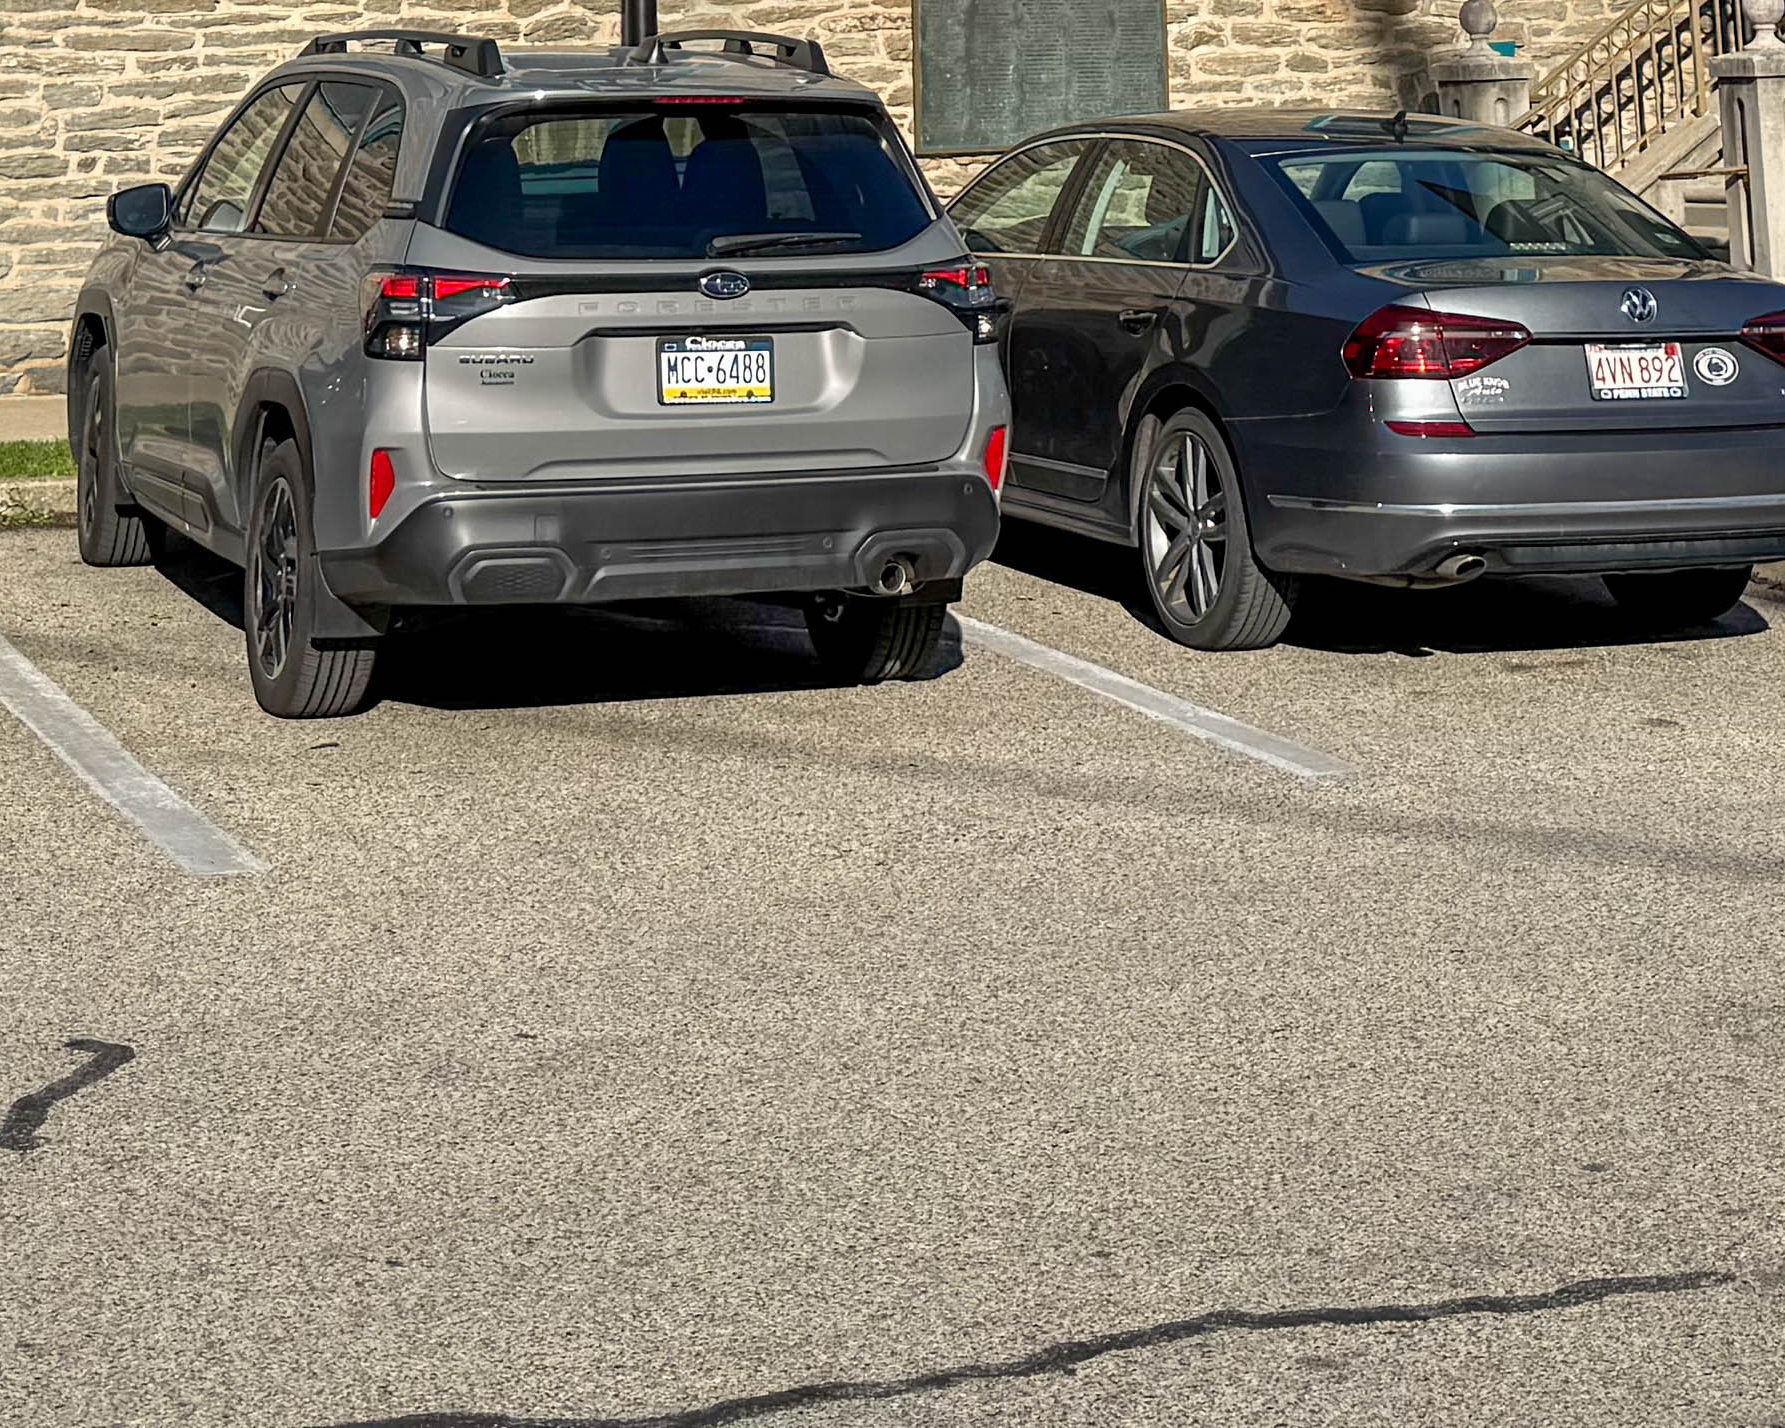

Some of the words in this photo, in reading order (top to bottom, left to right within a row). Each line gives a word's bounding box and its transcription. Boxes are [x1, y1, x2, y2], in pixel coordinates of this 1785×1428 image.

[578, 296, 857, 316] FORESTER
[1595, 355, 1634, 385] 4VN
[1638, 355, 1680, 384] 892
